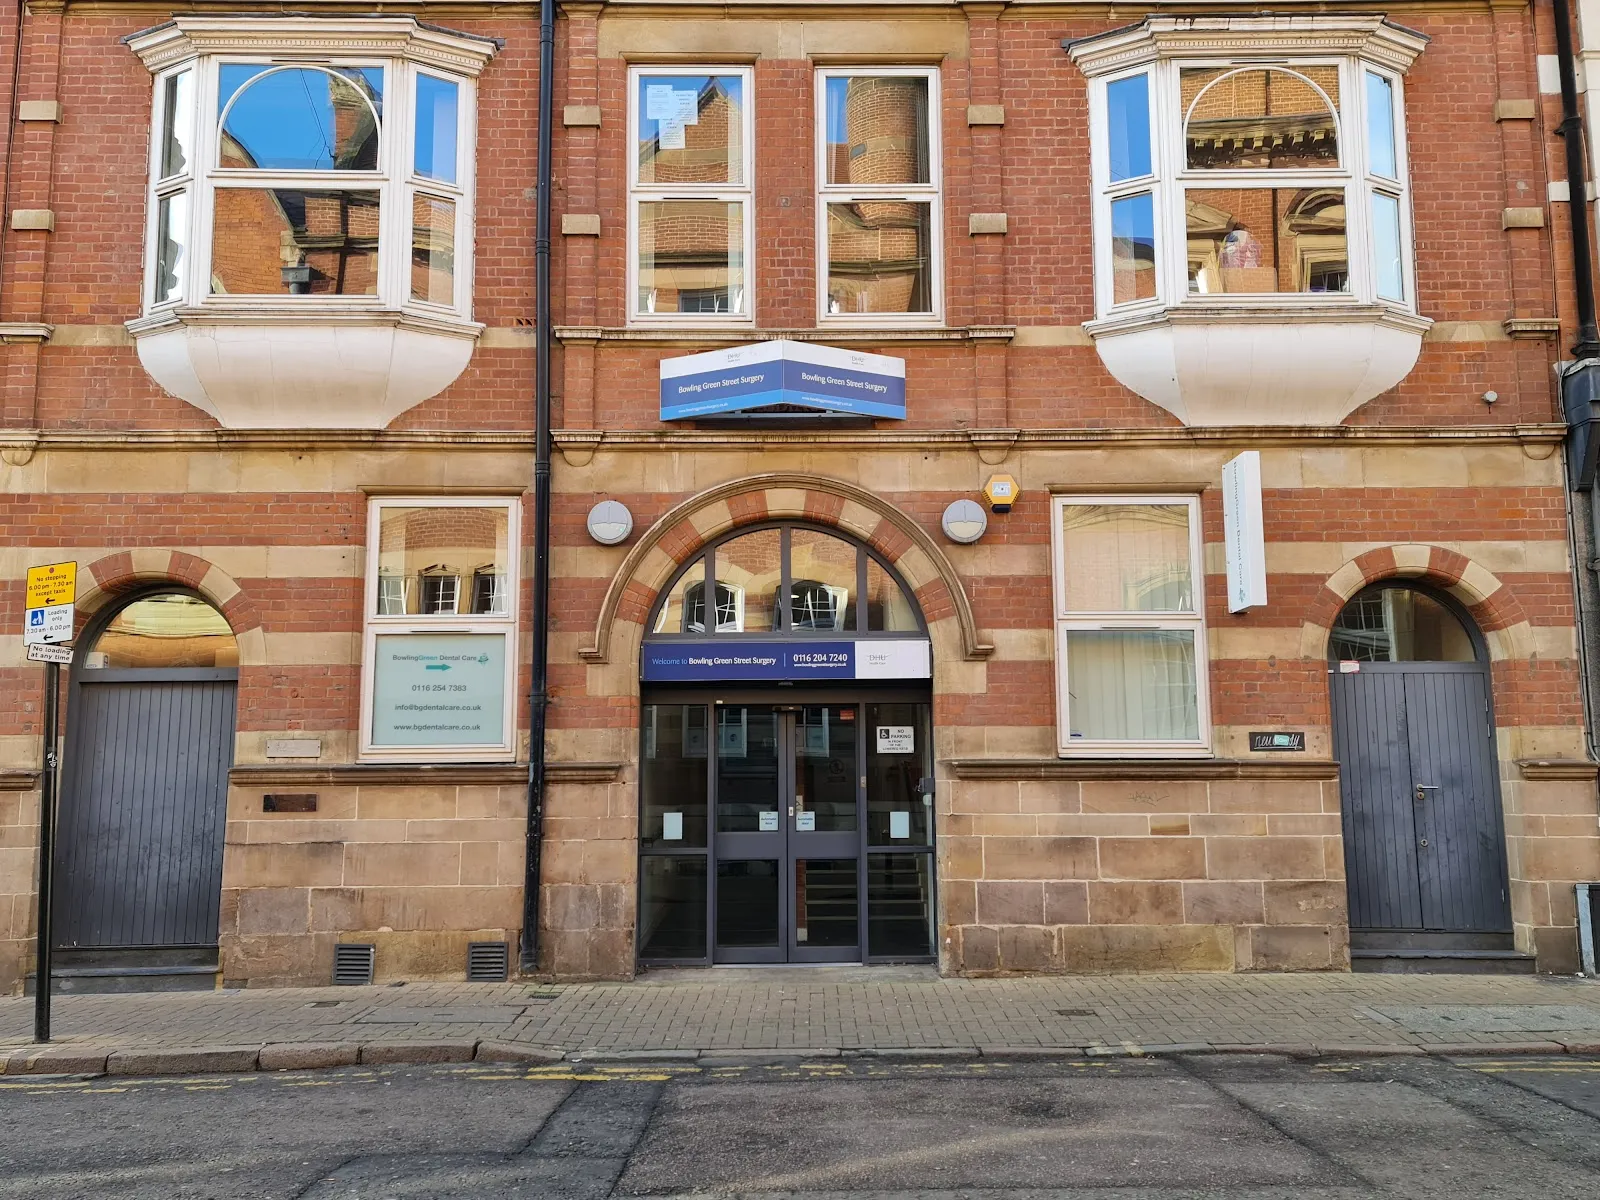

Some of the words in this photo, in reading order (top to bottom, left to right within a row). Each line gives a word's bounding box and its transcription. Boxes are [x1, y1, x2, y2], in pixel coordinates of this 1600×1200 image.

[678, 384, 702, 394] Bowling
[702, 381, 721, 389] Green
[721, 377, 740, 387] Street
[740, 374, 765, 383] Surgery
[801, 372, 826, 384] Bowling
[826, 376, 845, 386] Green
[846, 379, 864, 388] Street
[864, 382, 888, 393] Surgery
[49, 624, 62, 632] 6.00
[45, 647, 71, 656] loading
[652, 657, 680, 665] Welcome
[688, 657, 713, 666] Bowling
[713, 657, 733, 665] Green
[752, 656, 777, 666] Surgery
[793, 653, 812, 662] 0116
[812, 653, 827, 662] 204
[828, 653, 848, 662] 7240
[411, 684, 431, 692] 0116
[432, 684, 446, 692] 254
[448, 684, 467, 692] 7383
[394, 704, 482, 712] info@bgdentalcare.co.uk
